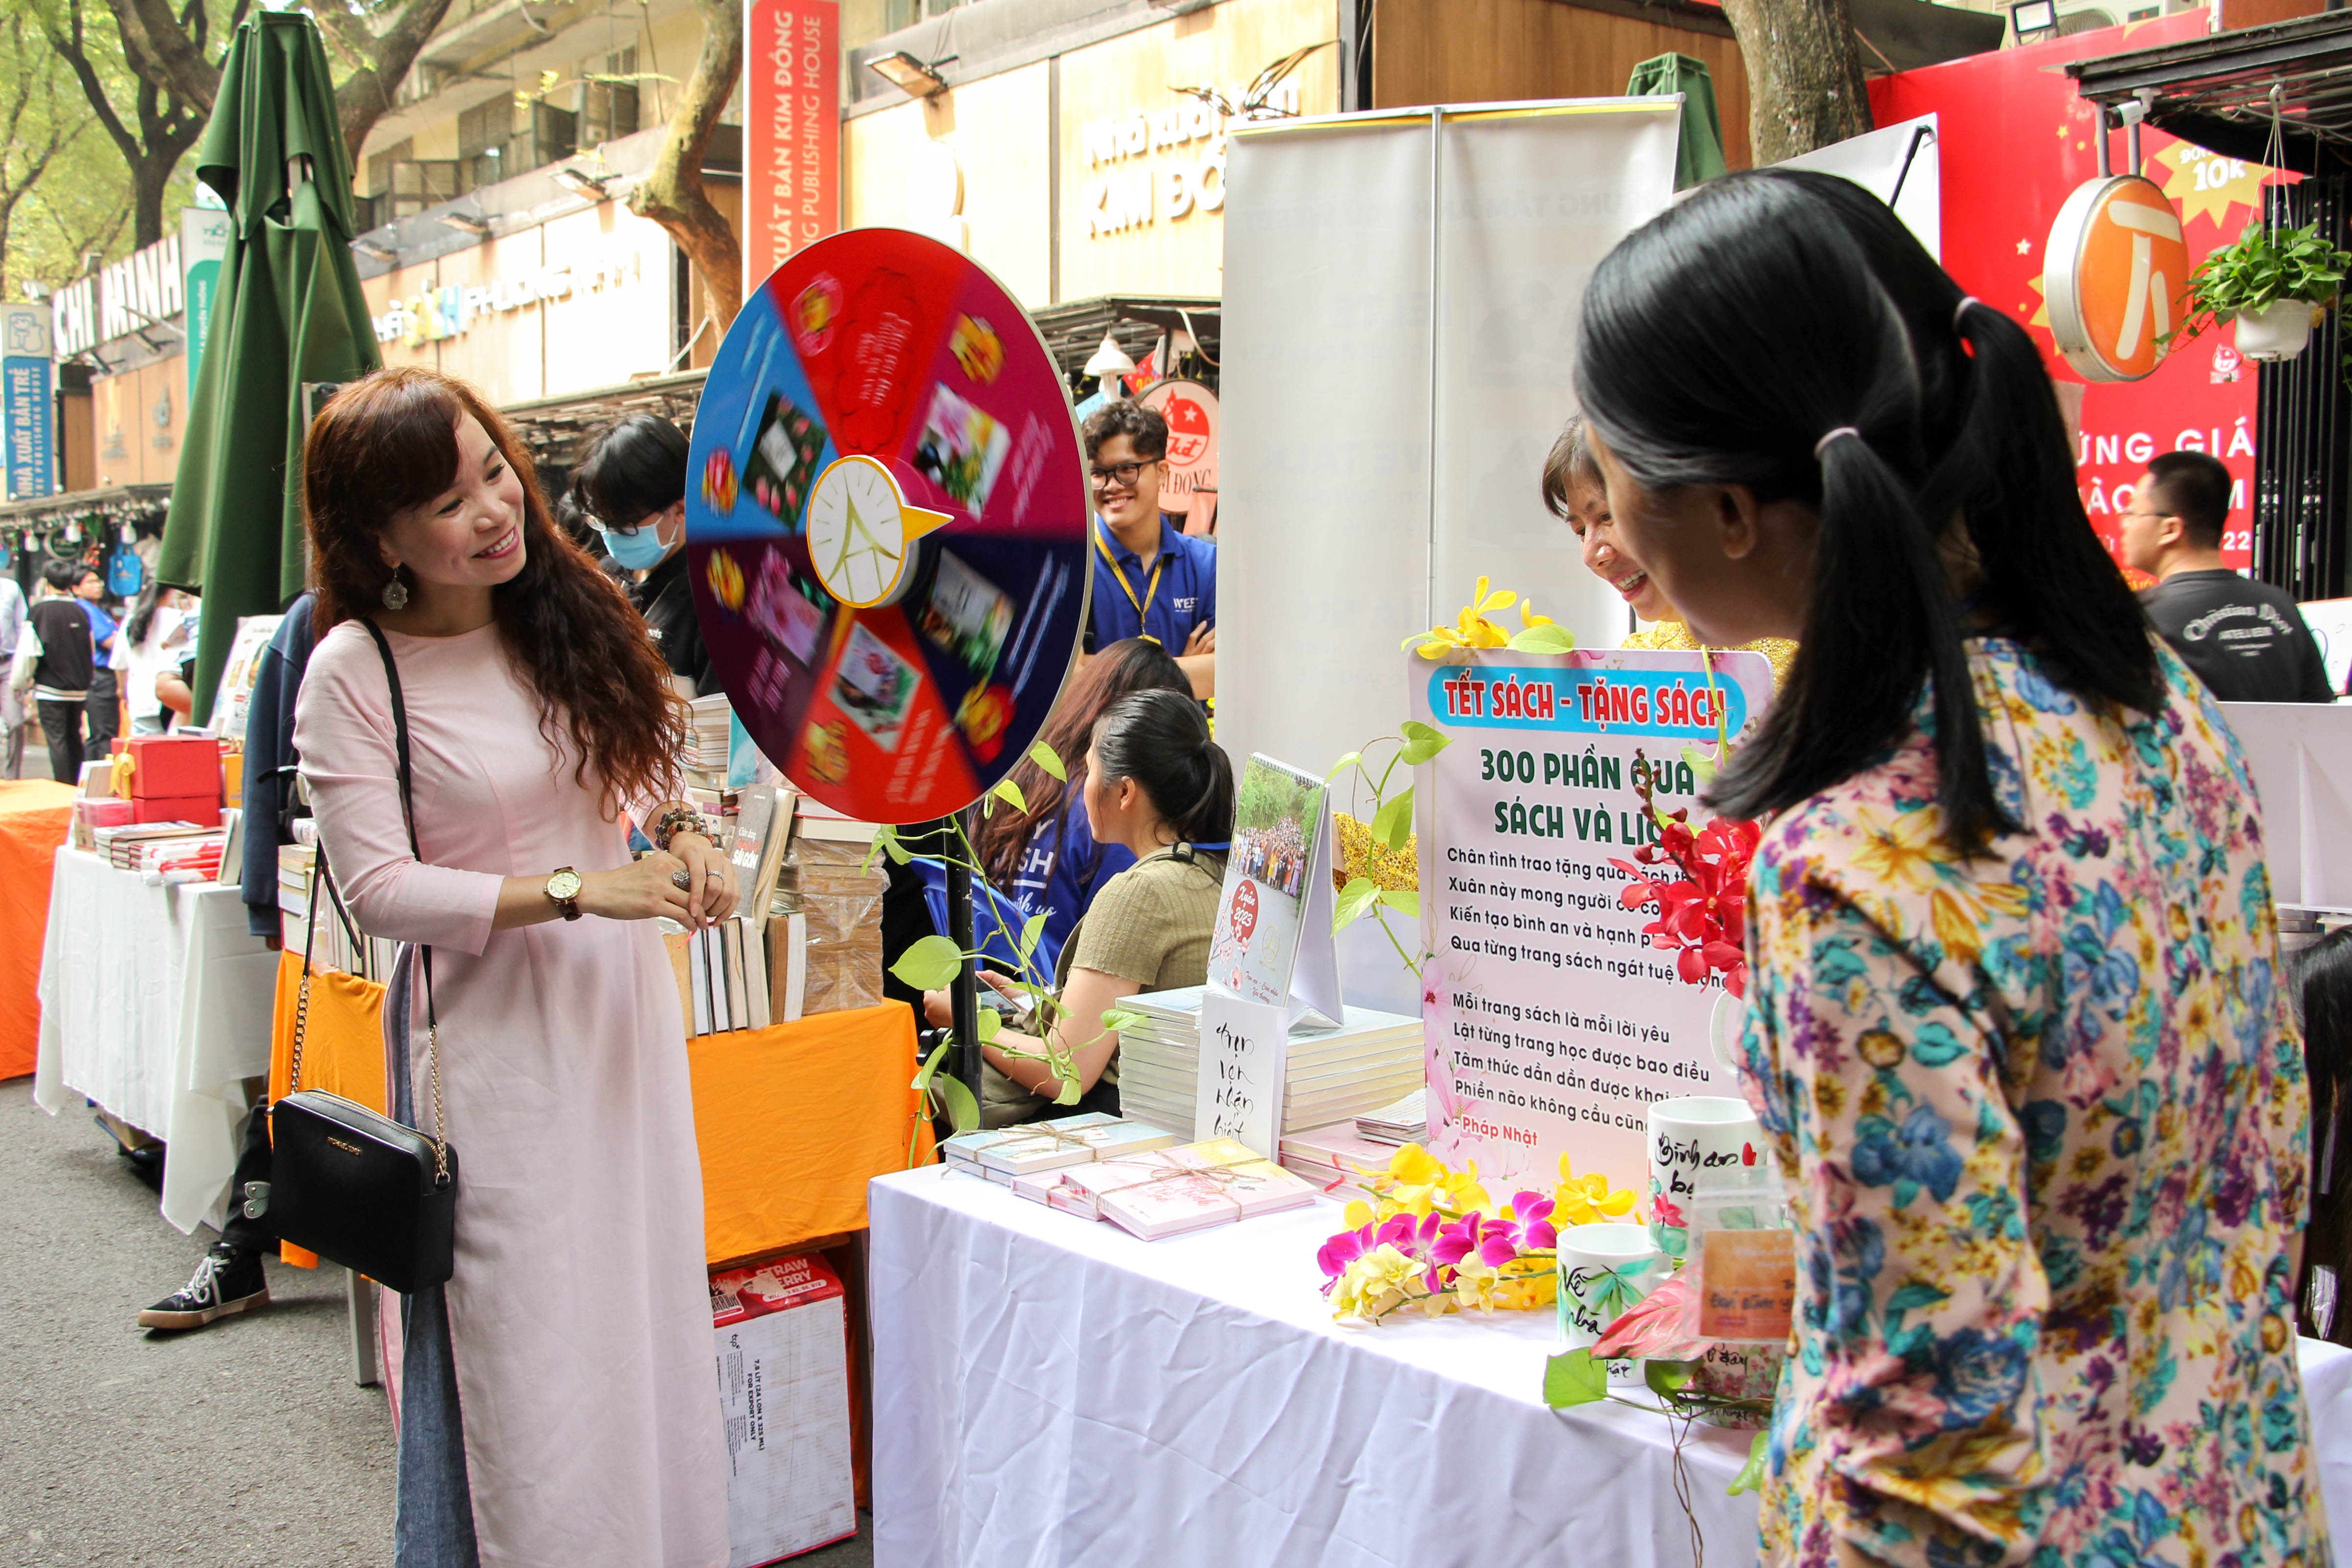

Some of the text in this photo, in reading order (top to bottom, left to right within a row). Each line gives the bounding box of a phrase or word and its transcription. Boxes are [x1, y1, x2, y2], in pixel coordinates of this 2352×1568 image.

[768, 10, 794, 87] ĐỒNG
[803, 15, 821, 89] HOUSE
[774, 94, 793, 141] KIM
[768, 148, 793, 199] BẢN
[802, 94, 820, 217] PUBLISHING
[2192, 157, 2247, 192] 10K
[1082, 139, 1227, 240] KIM ĐỒ
[52, 276, 96, 356] CHI
[99, 232, 183, 342] MINH
[7, 367, 30, 395] TRẺ
[9, 396, 32, 427] BẢN
[12, 466, 34, 497] NHÀ
[1444, 669, 1485, 716] TẾT
[1492, 676, 1554, 719] SÁCH
[1577, 678, 1648, 730] TẶNG
[1656, 681, 1725, 727] SÁCH
[1481, 749, 1535, 783] 300
[1543, 743, 1621, 790] PHẦN
[1494, 795, 1564, 839] SÁCH
[1572, 802, 1612, 843] VÀ
[1447, 847, 1485, 864] Chân
[1489, 850, 1517, 868] tình
[1521, 855, 1552, 871] trao
[1555, 858, 1591, 881] tặng
[1631, 866, 1669, 882] ách
[1237, 885, 1256, 907] Xuân
[1448, 876, 1486, 894] Xuân
[1490, 881, 1516, 901] này
[1521, 887, 1563, 908] mong
[1568, 892, 1611, 910] người
[1233, 907, 1253, 927] 2023
[1450, 905, 1481, 923] Kiến
[1485, 910, 1509, 929] tạo
[1513, 913, 1545, 932] bình
[1550, 922, 1568, 935] an
[1573, 921, 1592, 938] và
[1597, 925, 1636, 945] hạnh
[1451, 935, 1480, 952] Qua
[1484, 939, 1517, 961] từng
[1521, 945, 1561, 968] trang
[1566, 952, 1602, 972] sách
[1607, 959, 1644, 977] ngát
[1648, 963, 1674, 985] tuệ
[1453, 992, 1669, 1043] Mỗi trang sách là mỗi lời yêu
[1454, 1022, 1709, 1082] Lật từng trang học được bao điều
[1454, 1051, 1483, 1069] Tâm
[1487, 1057, 1519, 1076] thức
[1523, 1062, 1552, 1083] dần
[1556, 1068, 1586, 1090] dần
[1590, 1078, 1630, 1100] được
[1455, 1080, 1648, 1136] Phiền não không cầu cũn
[1463, 1116, 1499, 1139] Pháp
[1503, 1124, 1537, 1148] Nhật
[777, 1269, 812, 1286] ERRY
